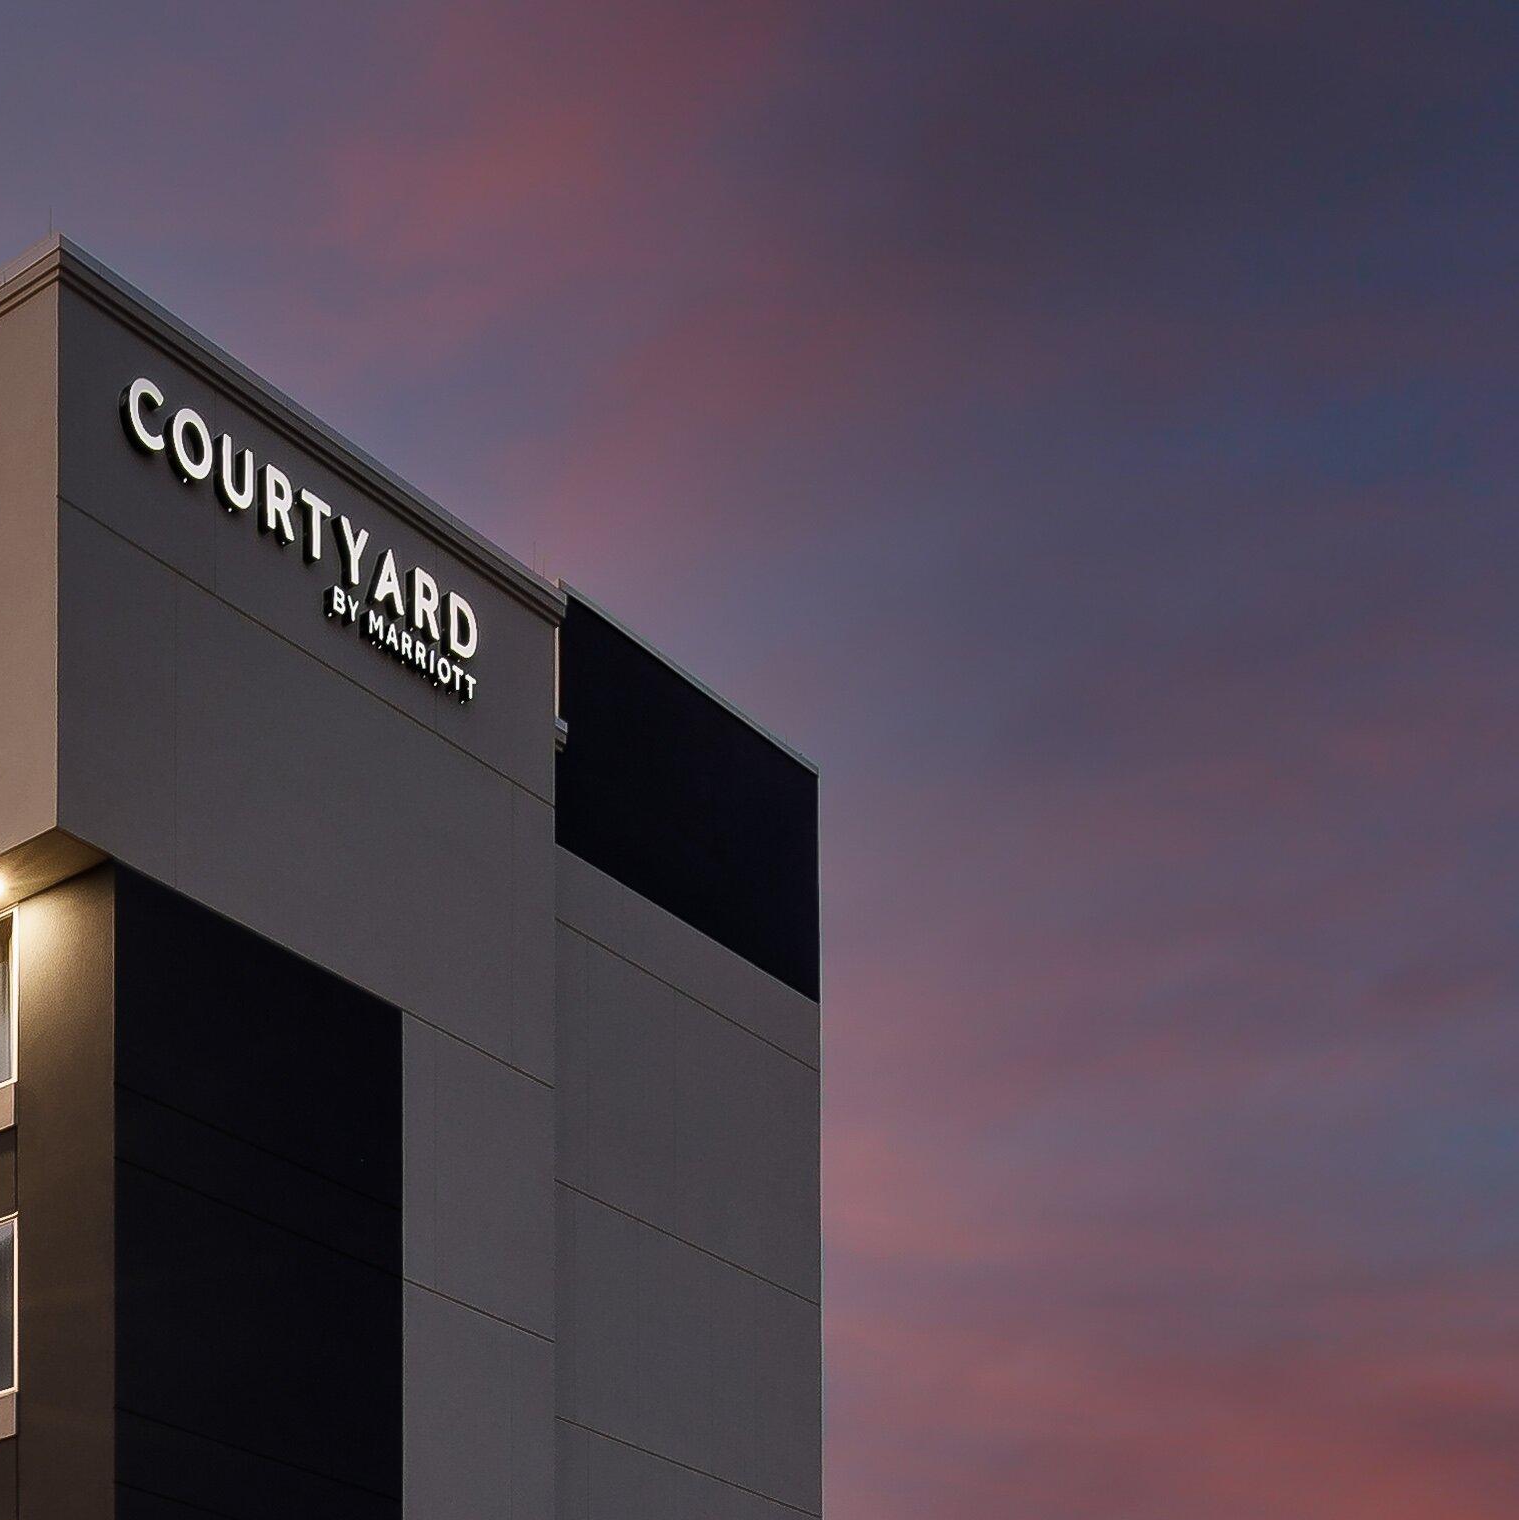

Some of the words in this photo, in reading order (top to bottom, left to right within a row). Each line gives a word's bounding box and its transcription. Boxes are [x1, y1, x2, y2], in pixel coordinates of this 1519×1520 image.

[127, 376, 479, 660] COURTYARD
[332, 584, 360, 623] BY
[367, 608, 478, 700] MARRIOTT
